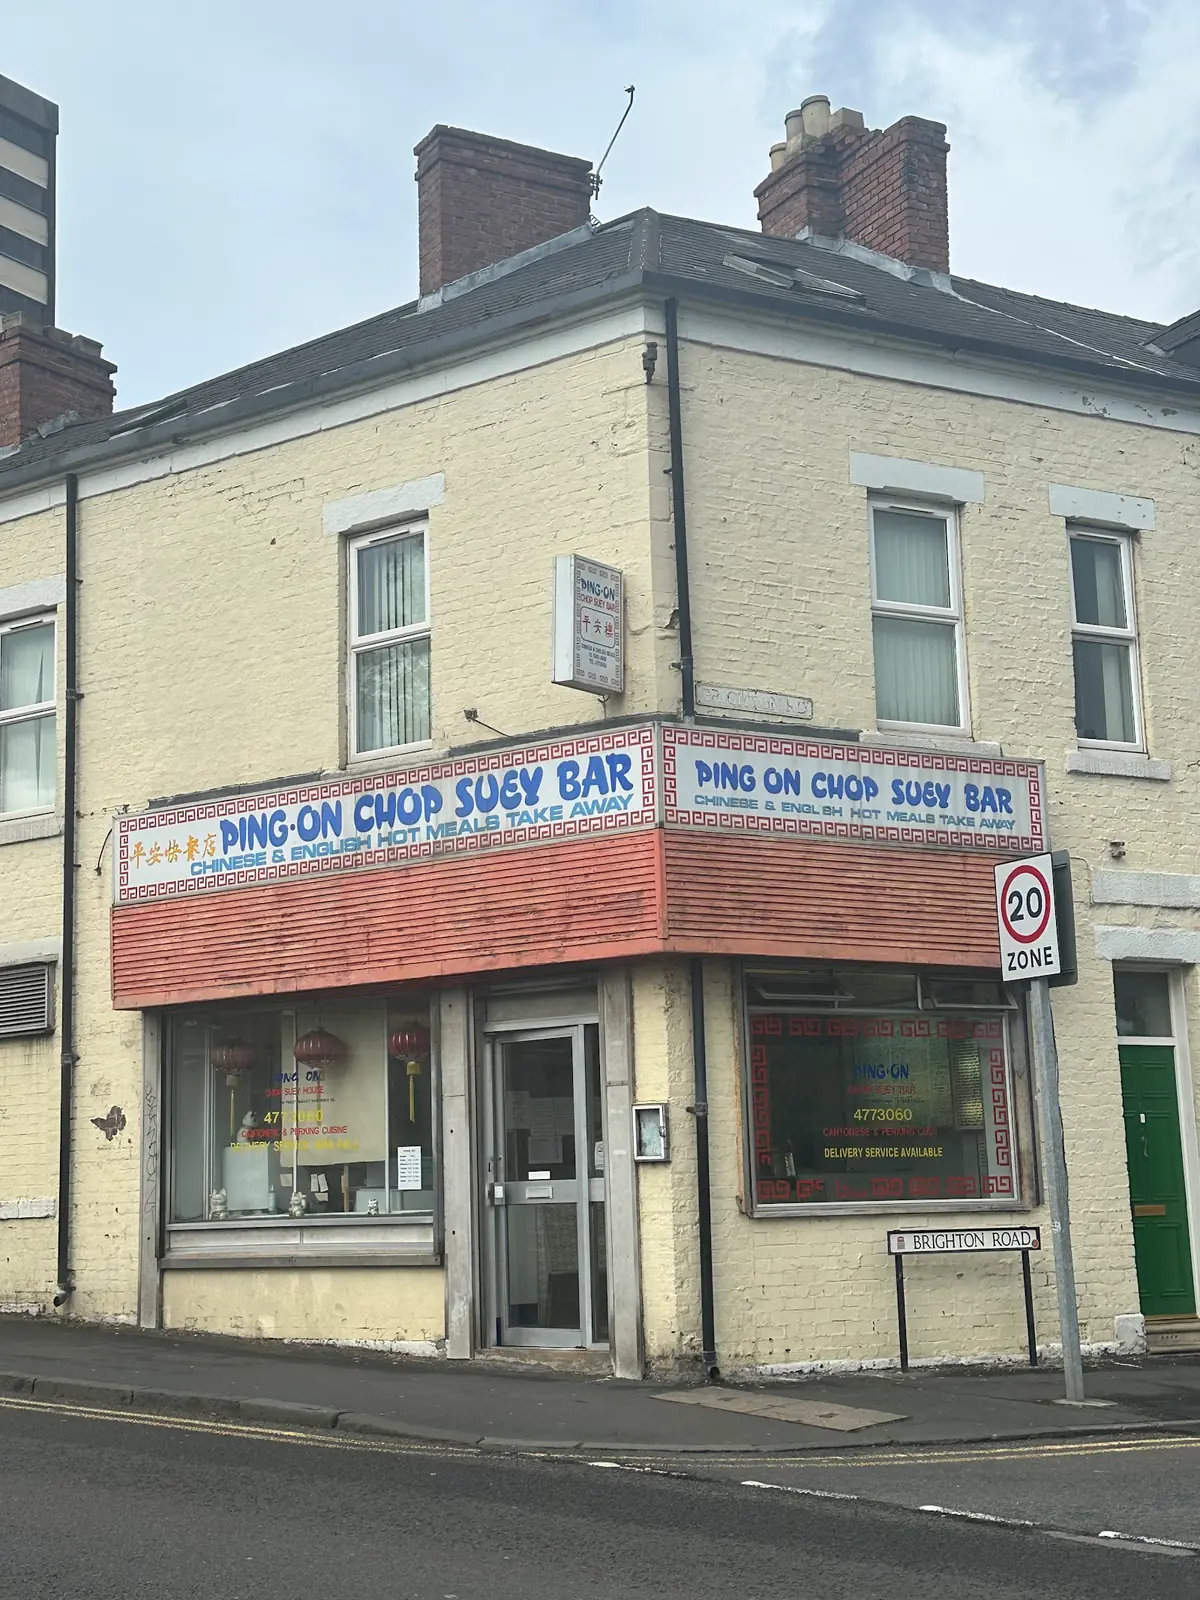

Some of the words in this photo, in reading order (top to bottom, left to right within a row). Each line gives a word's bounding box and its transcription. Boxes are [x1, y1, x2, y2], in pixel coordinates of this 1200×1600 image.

[353, 784, 443, 832] CHOP
[455, 766, 543, 817] SUEY
[557, 753, 634, 801] BAR
[695, 760, 756, 792] PING
[763, 768, 801, 796] ON
[811, 772, 879, 802] CHOP
[891, 779, 951, 807] SUEY
[964, 783, 1013, 814] BAR
[694, 795, 759, 810] CHINESE
[765, 800, 776, 811] &
[850, 808, 881, 820] HOT
[887, 811, 935, 824] MEALS
[940, 814, 975, 827] TAKE
[980, 818, 1016, 830] AWAY
[190, 850, 267, 876] CHINESE
[272, 849, 287, 864] &
[291, 834, 371, 861] ENGLISH
[378, 827, 421, 846] HOT
[426, 815, 500, 839] MEALS
[506, 804, 563, 827] TAKE
[570, 794, 634, 817] AWAY
[1008, 887, 1042, 922] 20
[1007, 946, 1053, 971] ZONE
[303, 1084, 325, 1095] HOUSE
[853, 1108, 913, 1121] 4773060
[321, 1125, 347, 1135] CUISINE
[824, 1147, 863, 1158] DELIVERY
[865, 1147, 899, 1158] SERVICE
[900, 1147, 943, 1157] AVAILABLE
[913, 1233, 985, 1250] BRIGHTON
[992, 1231, 1031, 1247] ROAD
